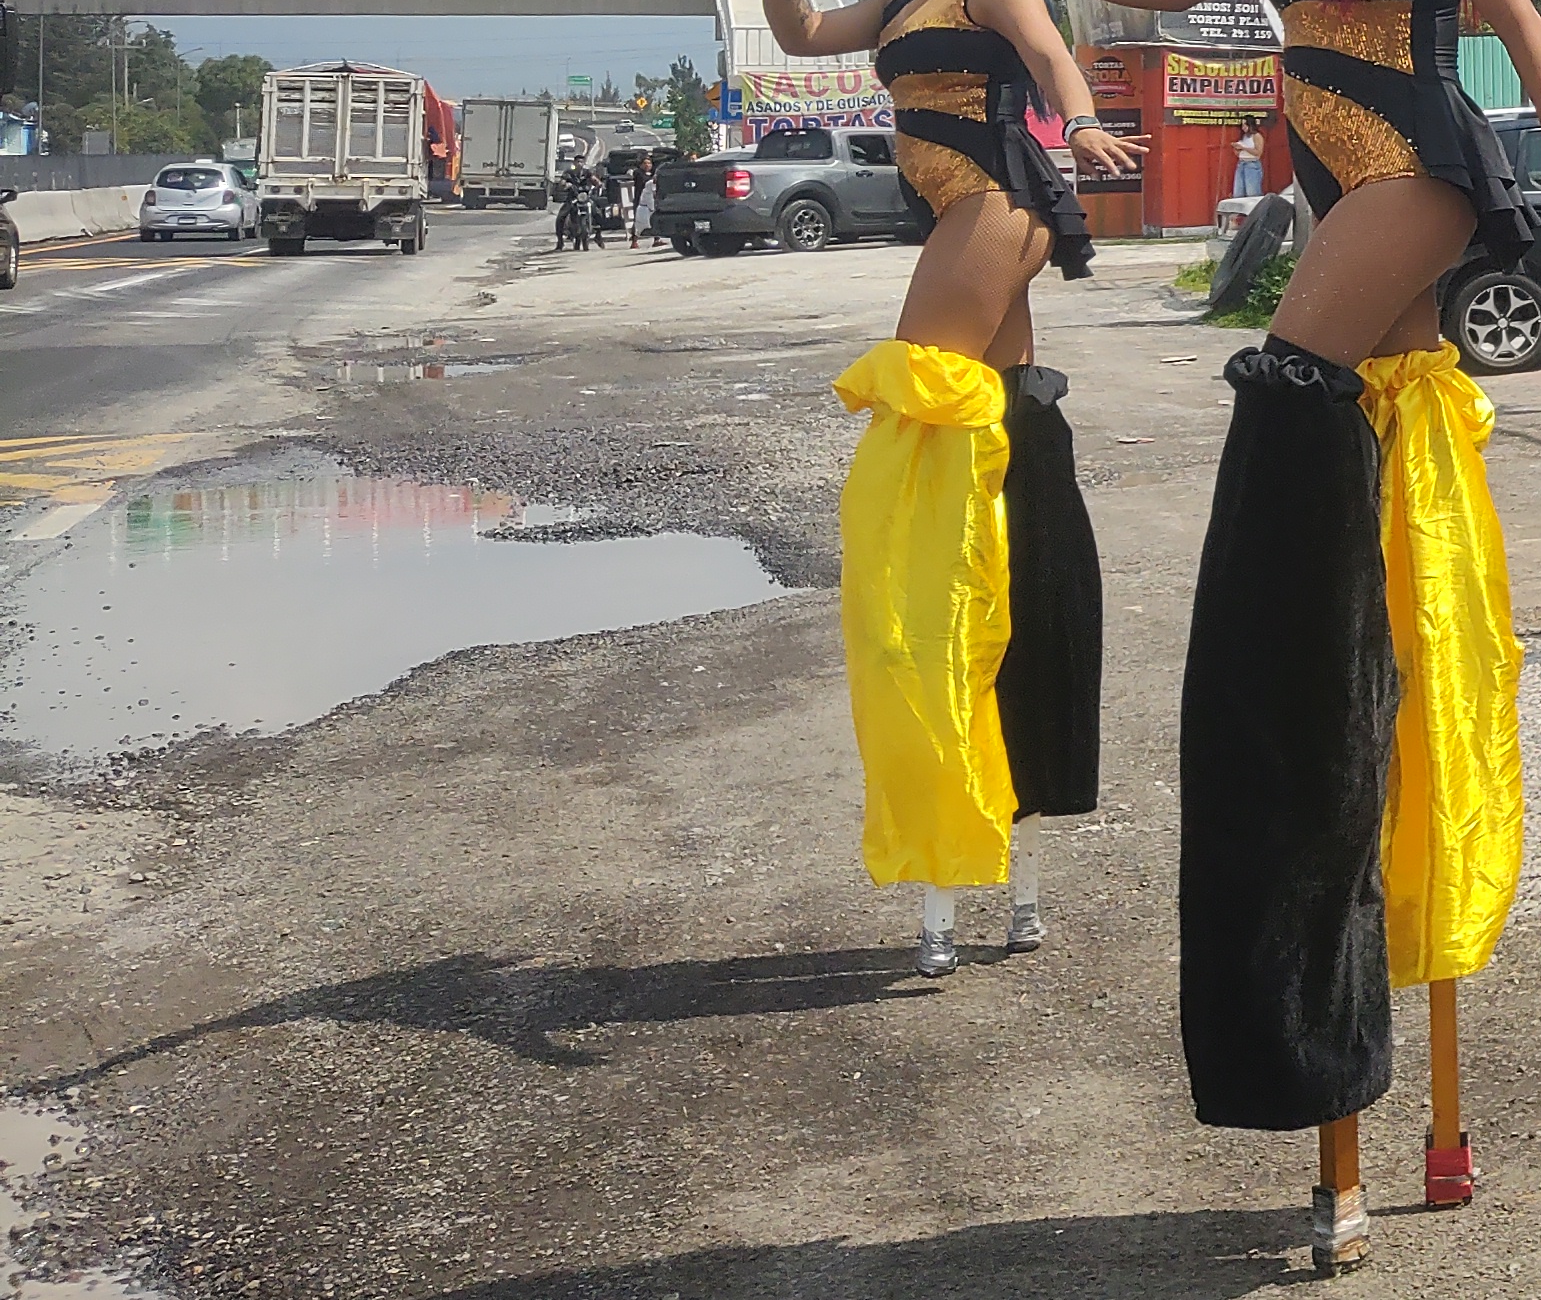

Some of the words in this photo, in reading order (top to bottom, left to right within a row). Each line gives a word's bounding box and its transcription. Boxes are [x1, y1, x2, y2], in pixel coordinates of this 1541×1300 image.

[1167, 53, 1189, 74] SE
[1168, 76, 1275, 94] EMPLEADA
[746, 101, 801, 113] ASADOS
[805, 100, 813, 111] Y
[816, 100, 832, 111] DE
